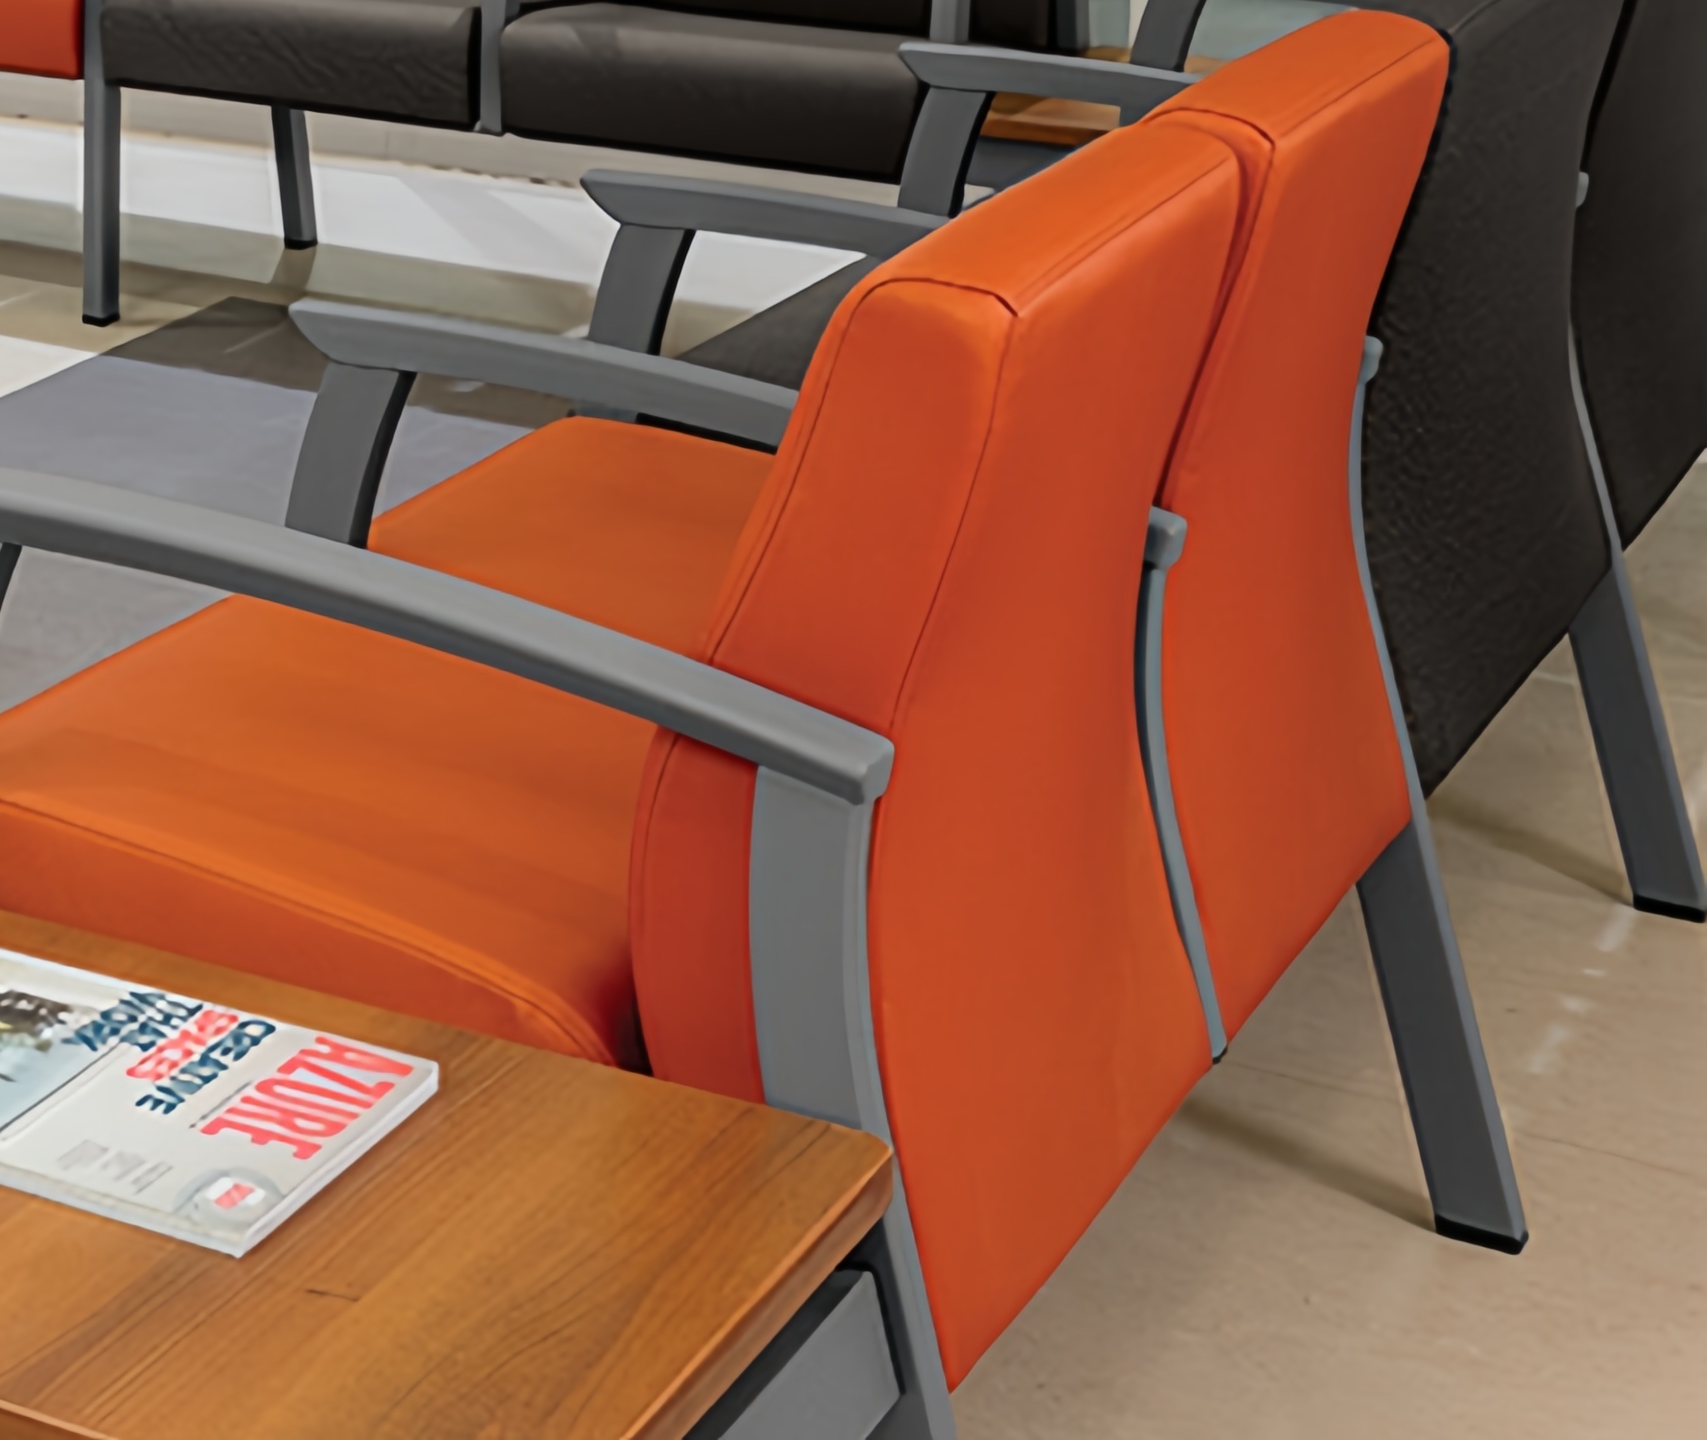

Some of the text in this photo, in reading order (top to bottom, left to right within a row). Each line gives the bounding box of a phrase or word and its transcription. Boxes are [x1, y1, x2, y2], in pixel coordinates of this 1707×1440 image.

[119, 996, 203, 1052] THAT
[125, 1009, 238, 1081] SPACES
[135, 1019, 276, 1114] CREATIVE
[199, 1035, 414, 1160] AZURE
